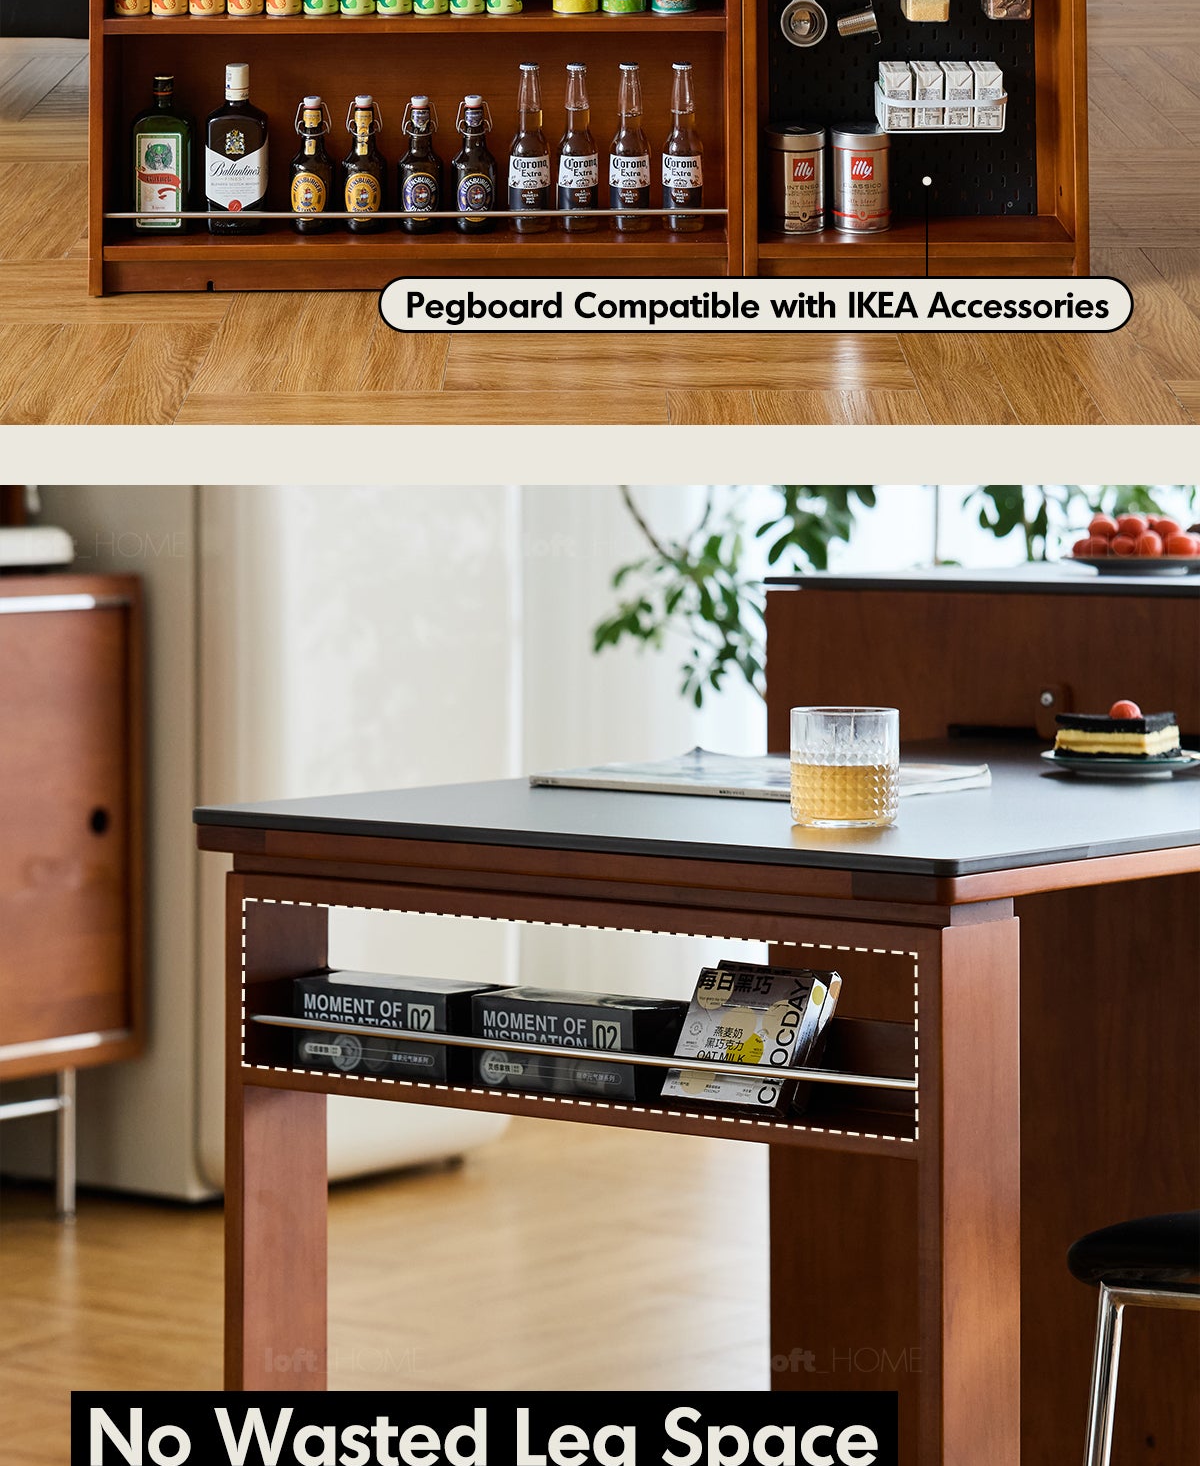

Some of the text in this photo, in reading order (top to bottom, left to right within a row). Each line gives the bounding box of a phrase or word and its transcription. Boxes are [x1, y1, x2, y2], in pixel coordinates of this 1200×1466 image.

[512, 158, 548, 169] Corona
[564, 158, 598, 169] Corona
[612, 157, 648, 168] Corona
[664, 157, 699, 169] Corona
[852, 160, 872, 179] illy
[521, 169, 542, 177] Extra
[573, 169, 593, 177] Extra
[621, 169, 641, 177] Extra
[672, 169, 691, 177] Extra
[794, 162, 814, 180] illy
[699, 970, 775, 995] 每日黑巧
[304, 993, 403, 1019] MOMENT OF
[410, 1008, 432, 1031] 02
[483, 1010, 587, 1035] MOMENT OF
[596, 1024, 618, 1049] 02
[714, 1026, 744, 1040] 燕麦奶
[705, 1037, 744, 1052] 黑巧克力
[757, 978, 811, 1105] COCDAY
